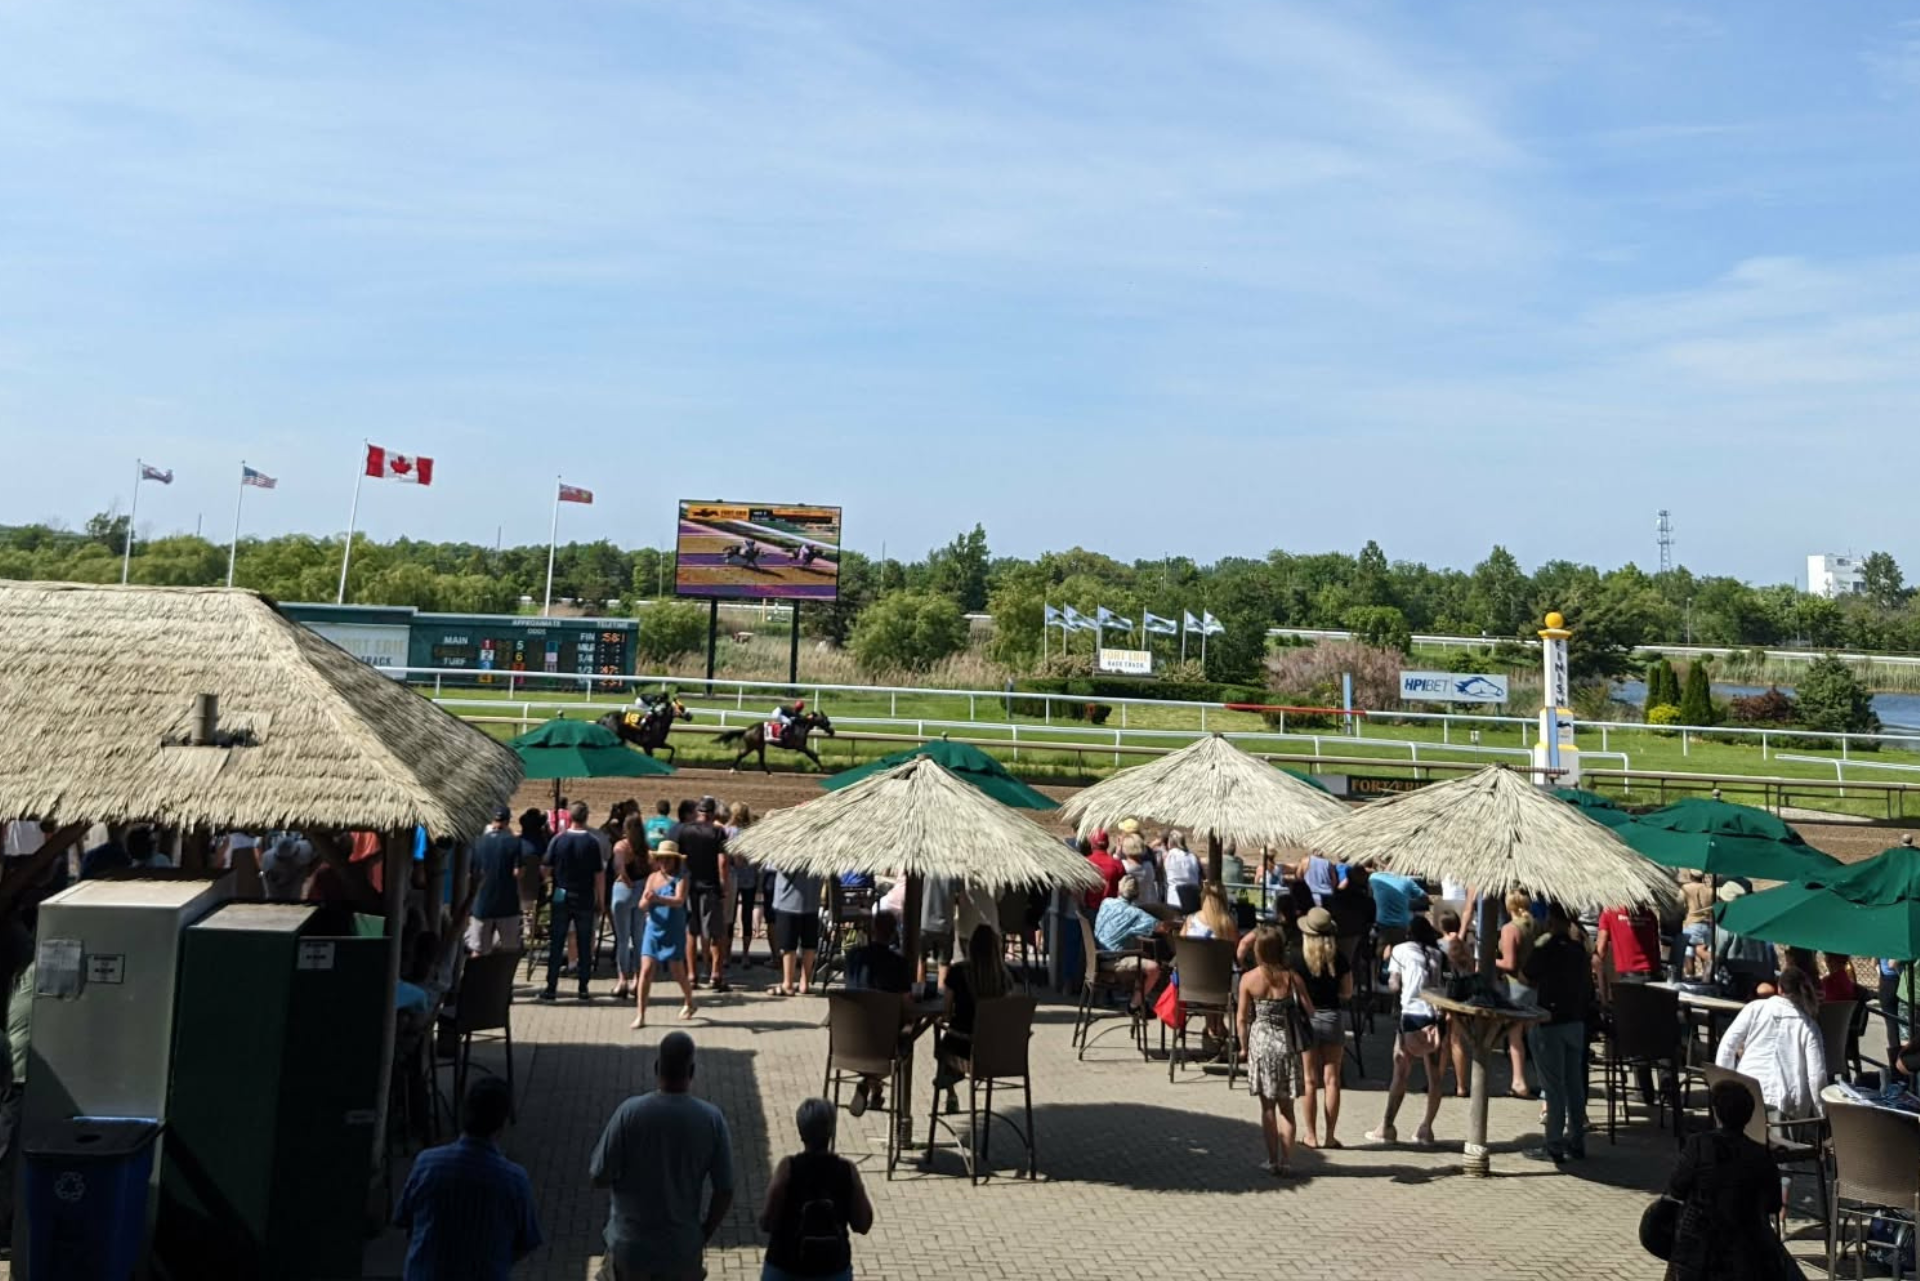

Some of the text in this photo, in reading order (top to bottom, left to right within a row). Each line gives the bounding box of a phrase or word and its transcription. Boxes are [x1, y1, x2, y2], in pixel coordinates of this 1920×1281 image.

[444, 636, 468, 645] MAIN
[580, 632, 595, 641] FIN
[516, 640, 524, 650] 5
[516, 652, 523, 661] 6
[444, 657, 466, 666] TURF
[1554, 639, 1565, 706] FINISH
[1404, 678, 1449, 692] HPIBET
